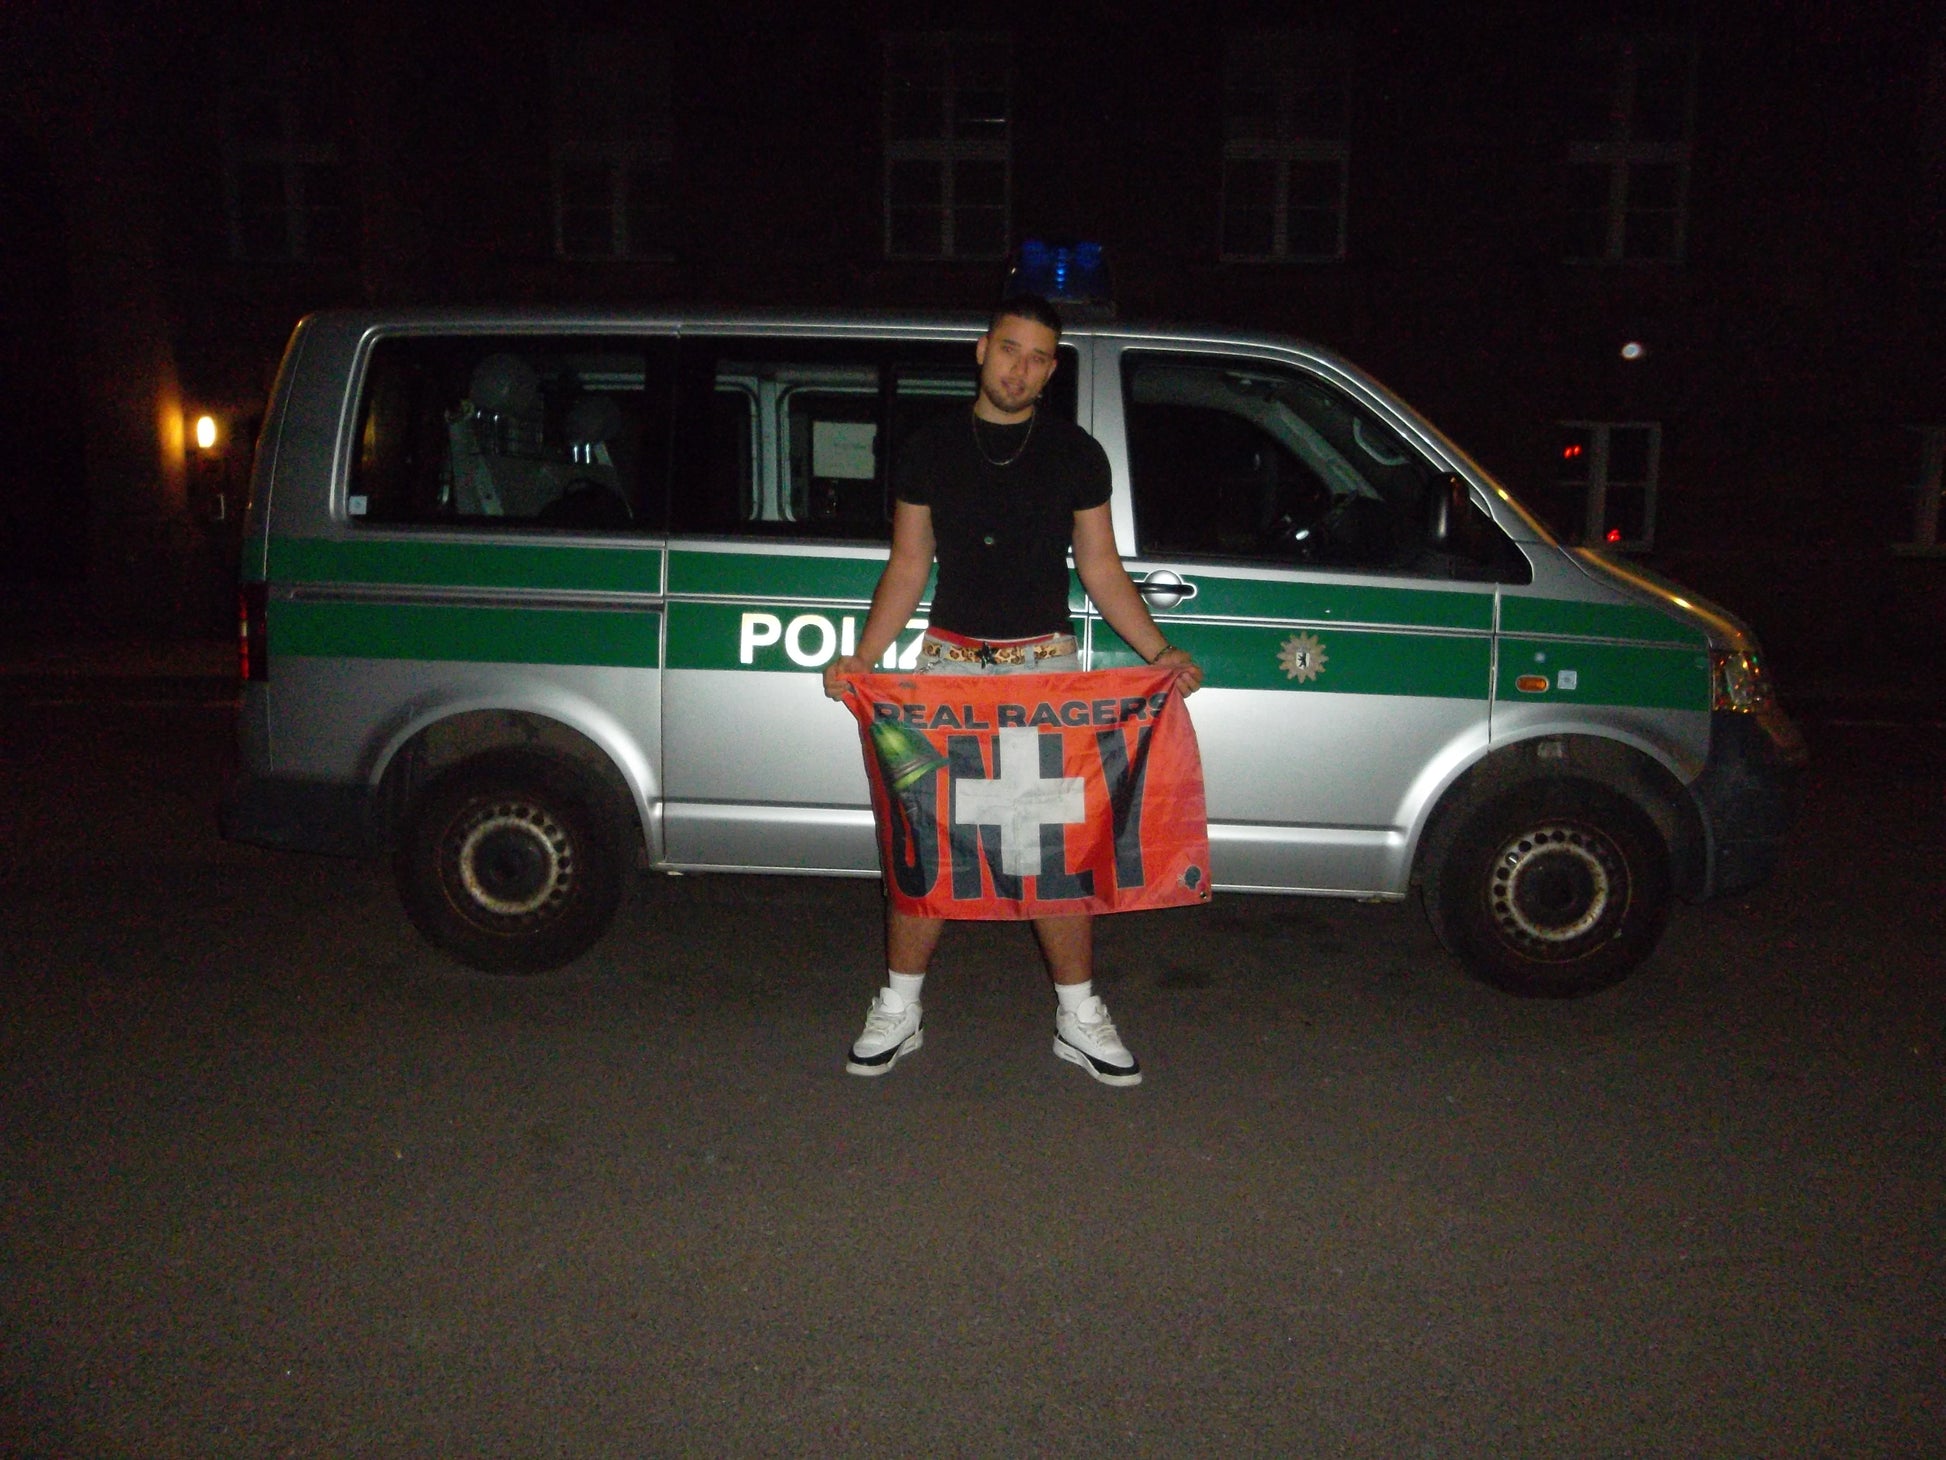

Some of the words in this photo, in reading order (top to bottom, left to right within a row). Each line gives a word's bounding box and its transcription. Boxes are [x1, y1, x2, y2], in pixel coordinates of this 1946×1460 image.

[873, 702, 989, 729] REAL
[998, 691, 1168, 728] RAGERS
[882, 725, 1152, 899] ONLY
